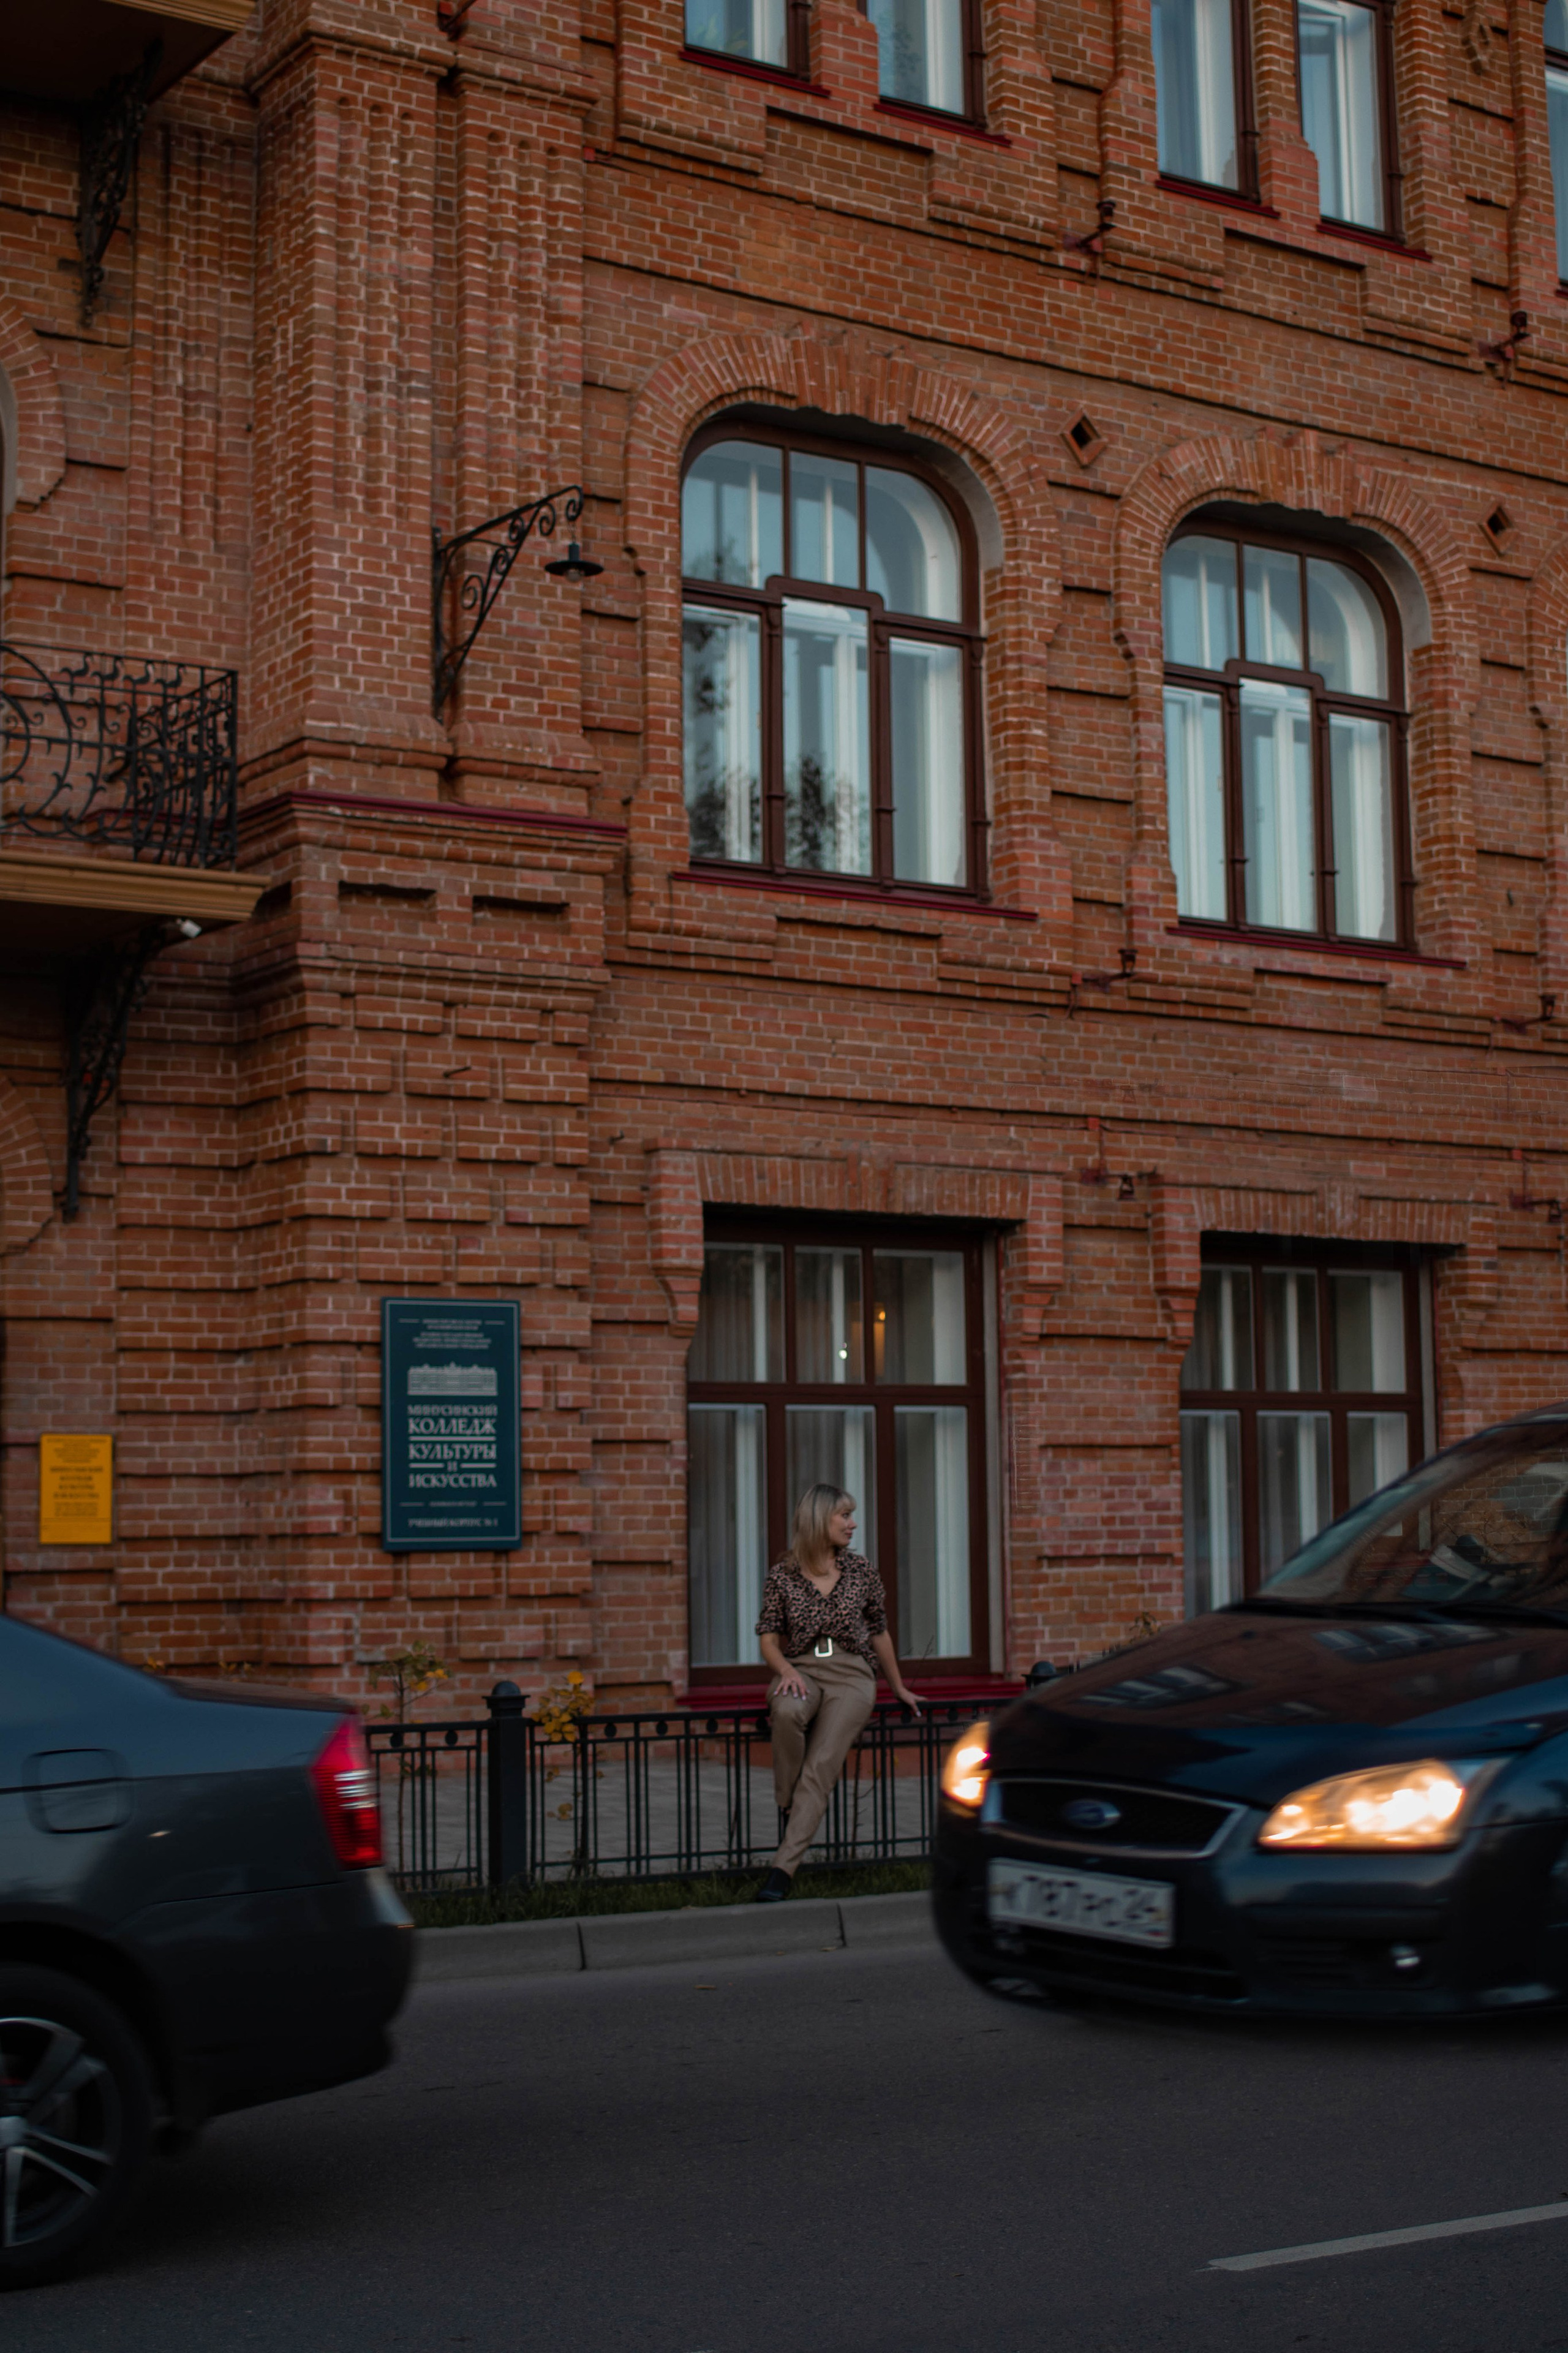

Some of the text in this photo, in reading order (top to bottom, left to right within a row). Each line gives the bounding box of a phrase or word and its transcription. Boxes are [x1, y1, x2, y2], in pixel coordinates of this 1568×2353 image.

[408, 1417, 497, 1435] КОЛЛЕДЖ
[408, 1443, 497, 1460] КУЛЬТУРЫ
[447, 1460, 458, 1472] И
[408, 1473, 497, 1488] ИСКУССТВА
